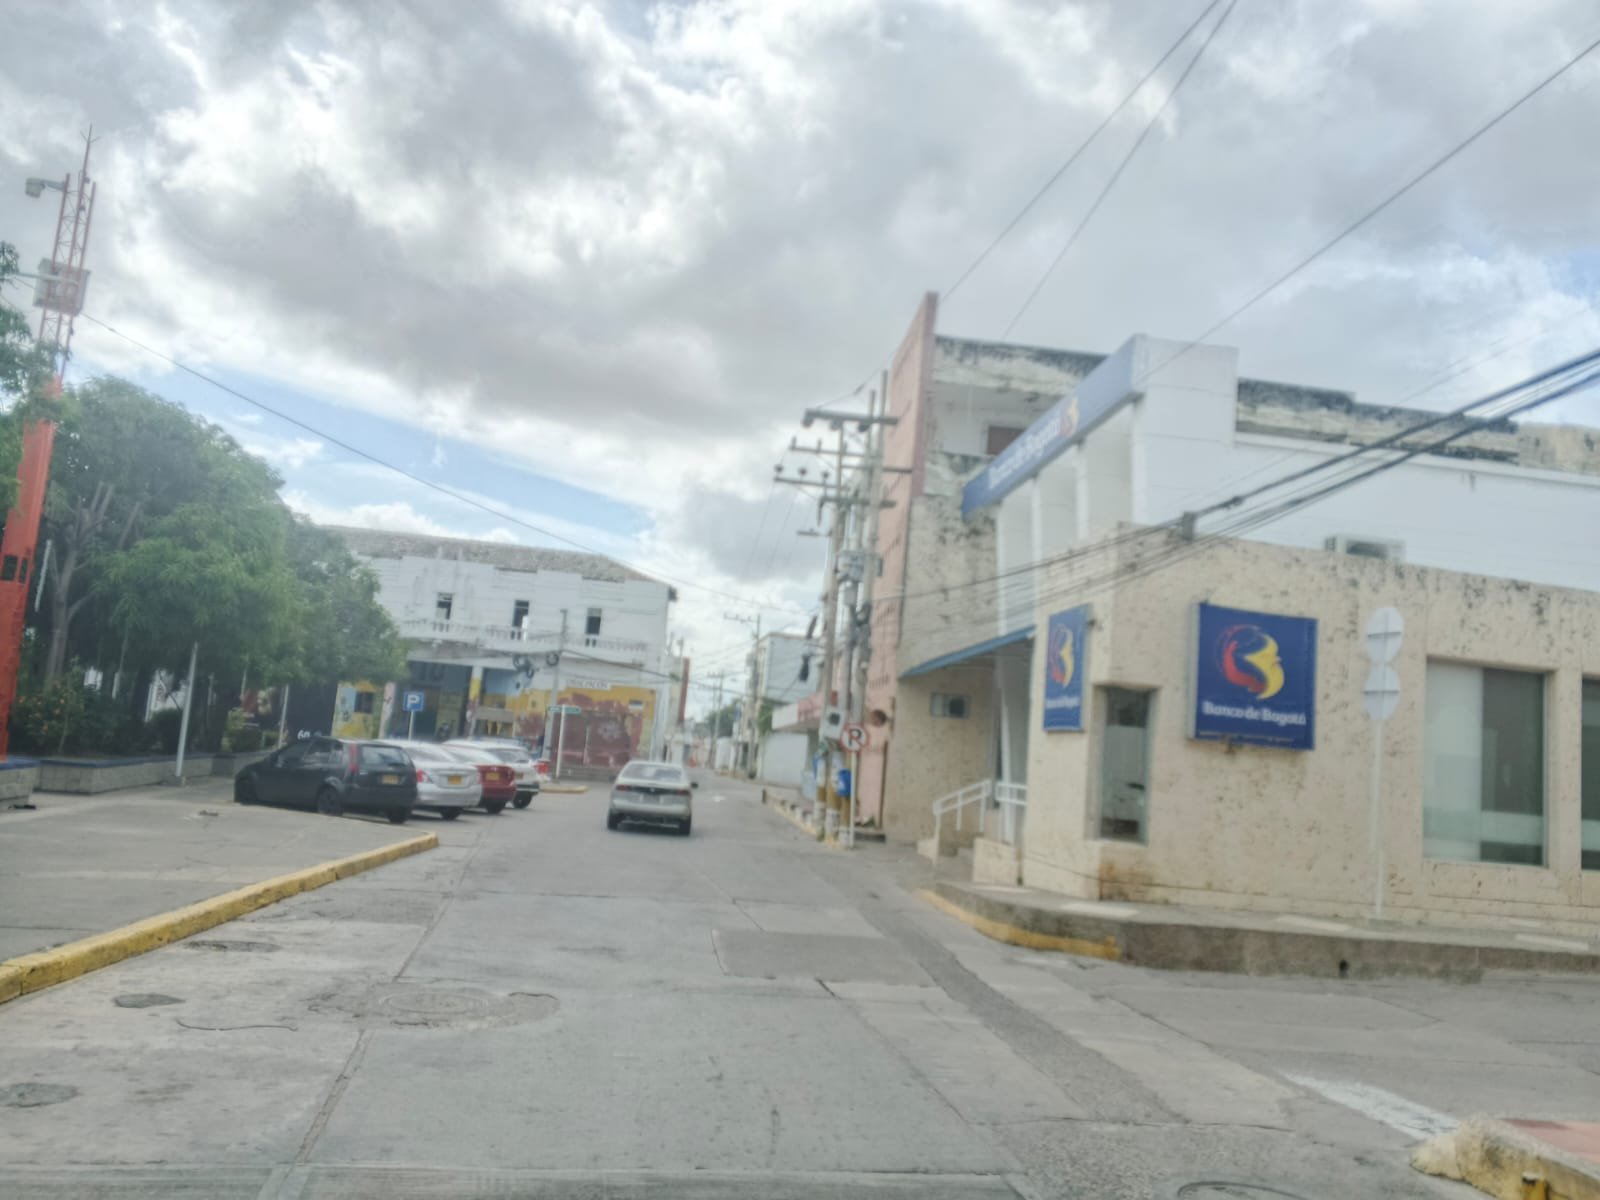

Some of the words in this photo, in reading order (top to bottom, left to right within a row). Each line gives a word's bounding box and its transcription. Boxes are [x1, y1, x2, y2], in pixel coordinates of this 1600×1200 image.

[407, 694, 420, 709] P
[1202, 701, 1243, 718] Banco
[1244, 706, 1261, 721] de
[848, 728, 862, 747] P
